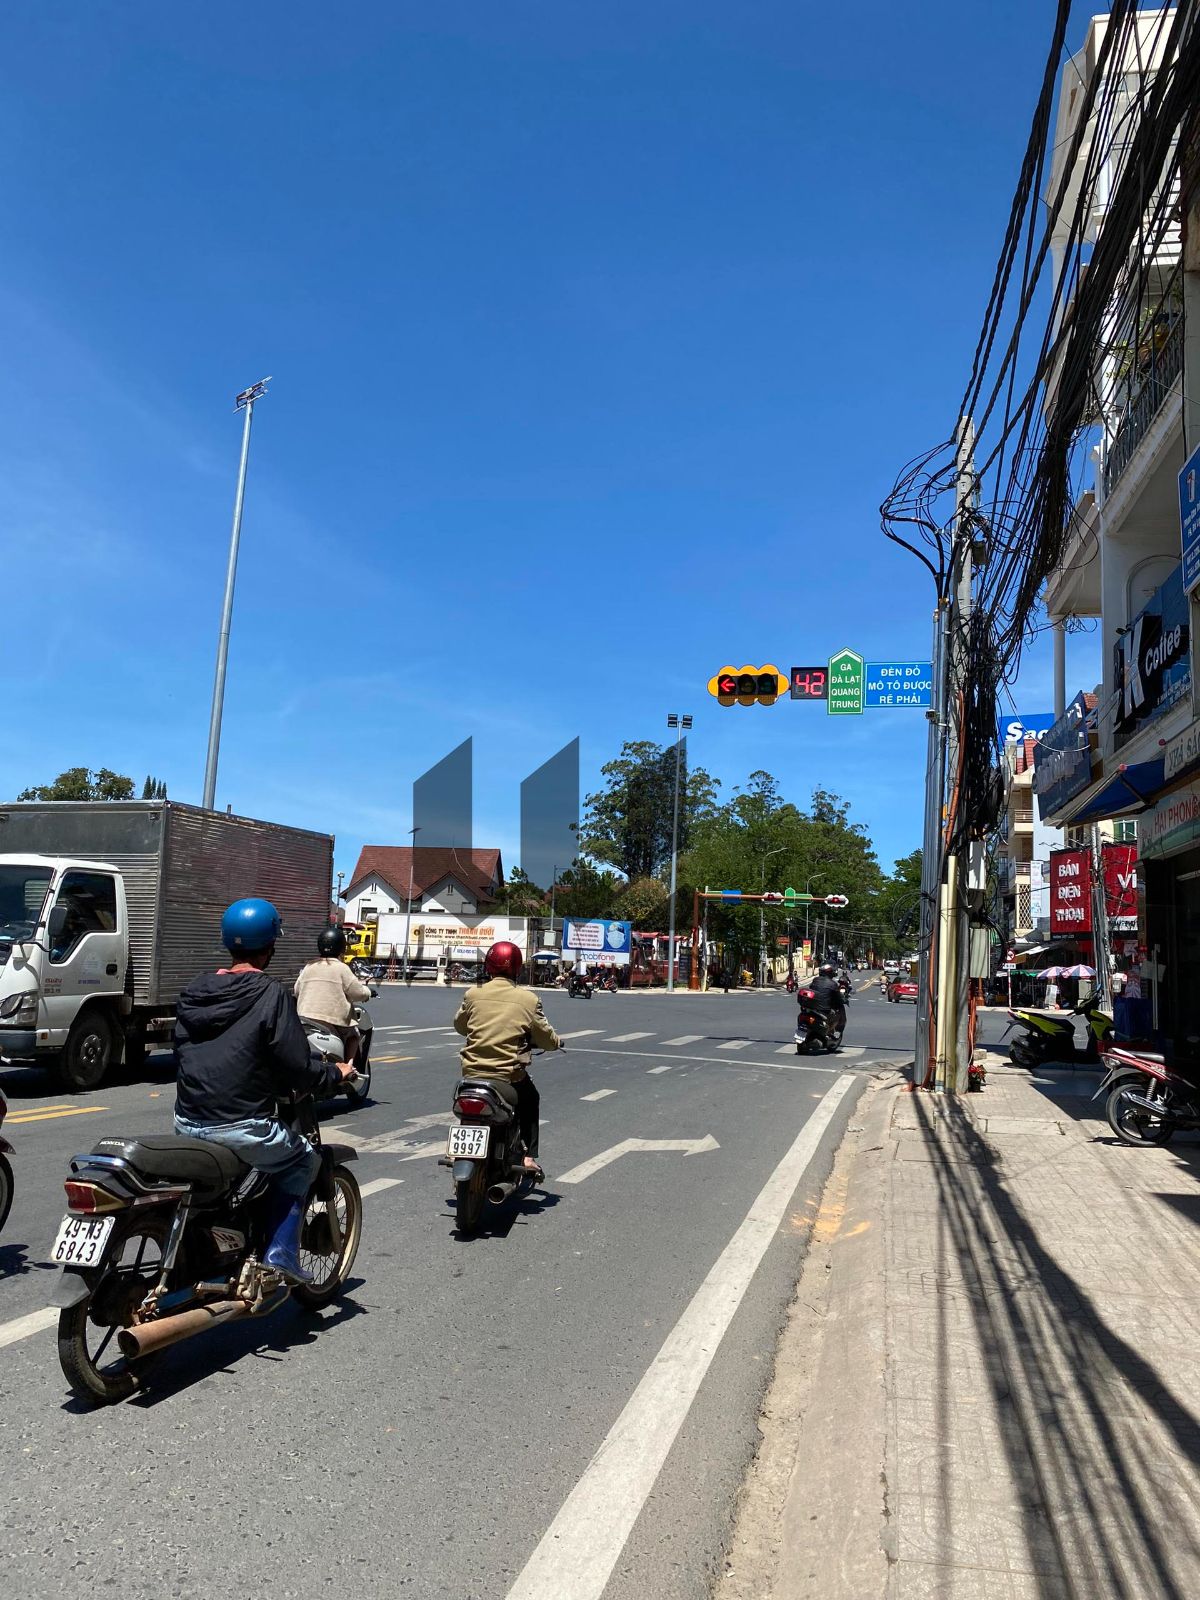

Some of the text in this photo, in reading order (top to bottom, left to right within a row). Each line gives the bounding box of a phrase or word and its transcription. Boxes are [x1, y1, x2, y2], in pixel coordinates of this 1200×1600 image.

[1145, 623, 1181, 677] Coffee
[840, 663, 853, 671] GA
[881, 665, 921, 677] ĐÈN ĐỎ
[795, 672, 825, 696] 42
[832, 674, 861, 685] ĐÀ LẠT
[868, 680, 932, 692] MÔ TÔ ĐƯỢC
[831, 687, 860, 696] QUANG
[831, 700, 860, 709] TRUNG
[879, 693, 921, 704] RẼ PHẢI
[1058, 859, 1080, 877] BÁN
[1057, 882, 1081, 901] ĐIỆN
[1055, 907, 1085, 923] THOẠI
[580, 952, 616, 962] mobifone
[453, 1129, 483, 1142] 49-T2
[453, 1142, 481, 1155] 9997
[64, 1217, 104, 1241] 49-N3
[56, 1240, 97, 1263] 6843
